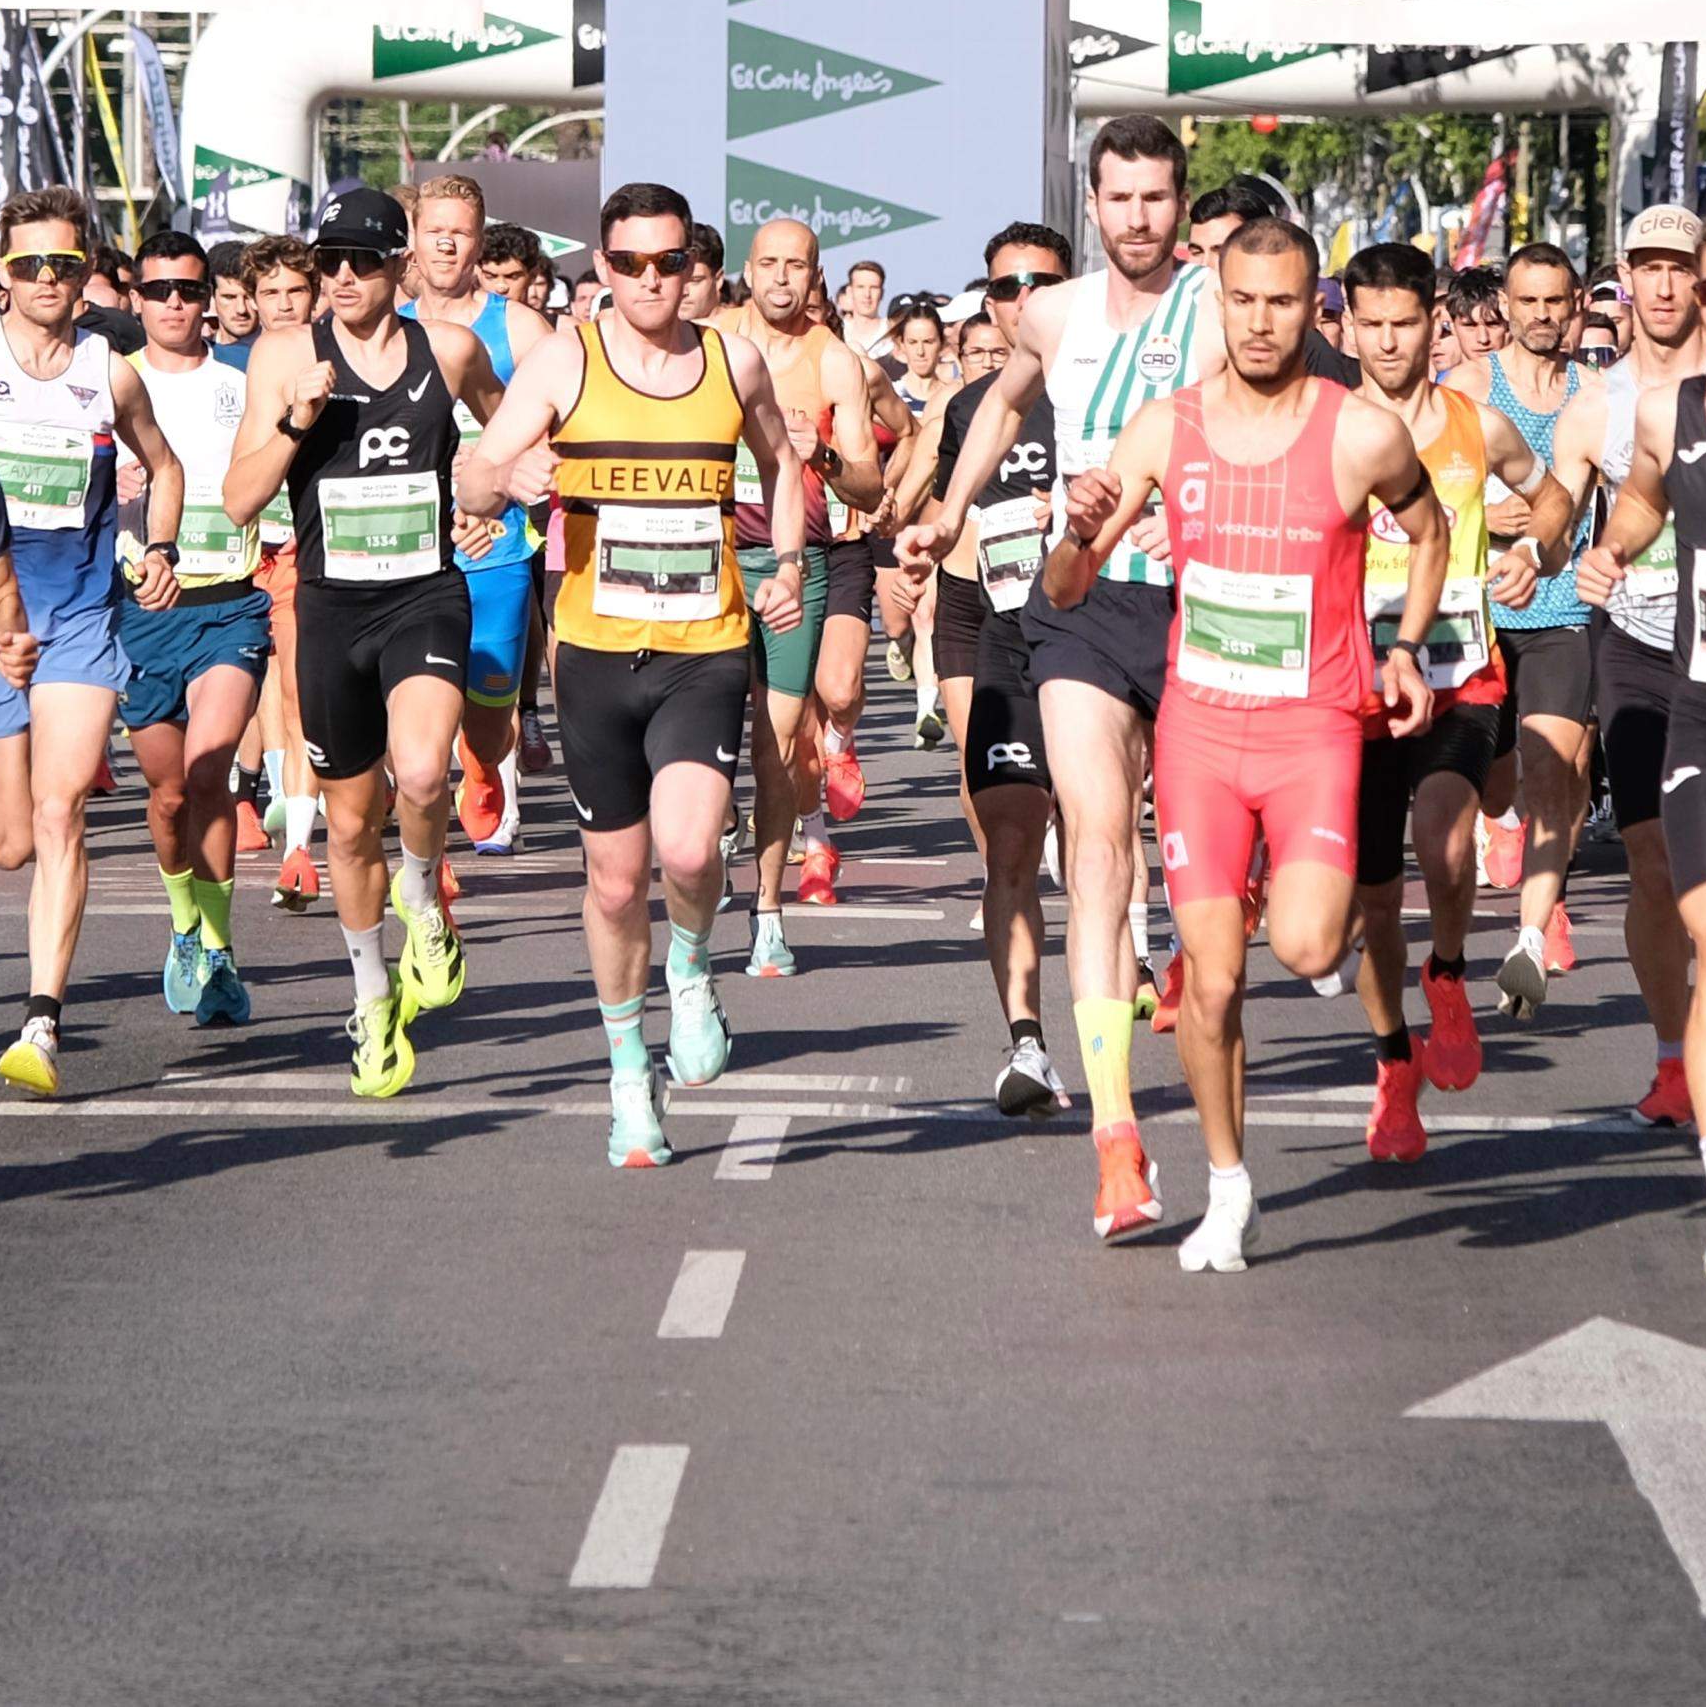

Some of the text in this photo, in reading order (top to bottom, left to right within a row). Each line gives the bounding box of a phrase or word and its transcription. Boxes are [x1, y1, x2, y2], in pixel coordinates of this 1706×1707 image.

[730, 60, 893, 101] El Corte Inglés
[729, 198, 755, 225] El
[808, 196, 892, 236] Inglés
[1639, 214, 1695, 237] ciele
[21, 484, 42, 497] 411
[182, 532, 208, 545] 706
[365, 534, 398, 548] 1334
[1285, 527, 1325, 543] tribe
[653, 572, 669, 586] 19
